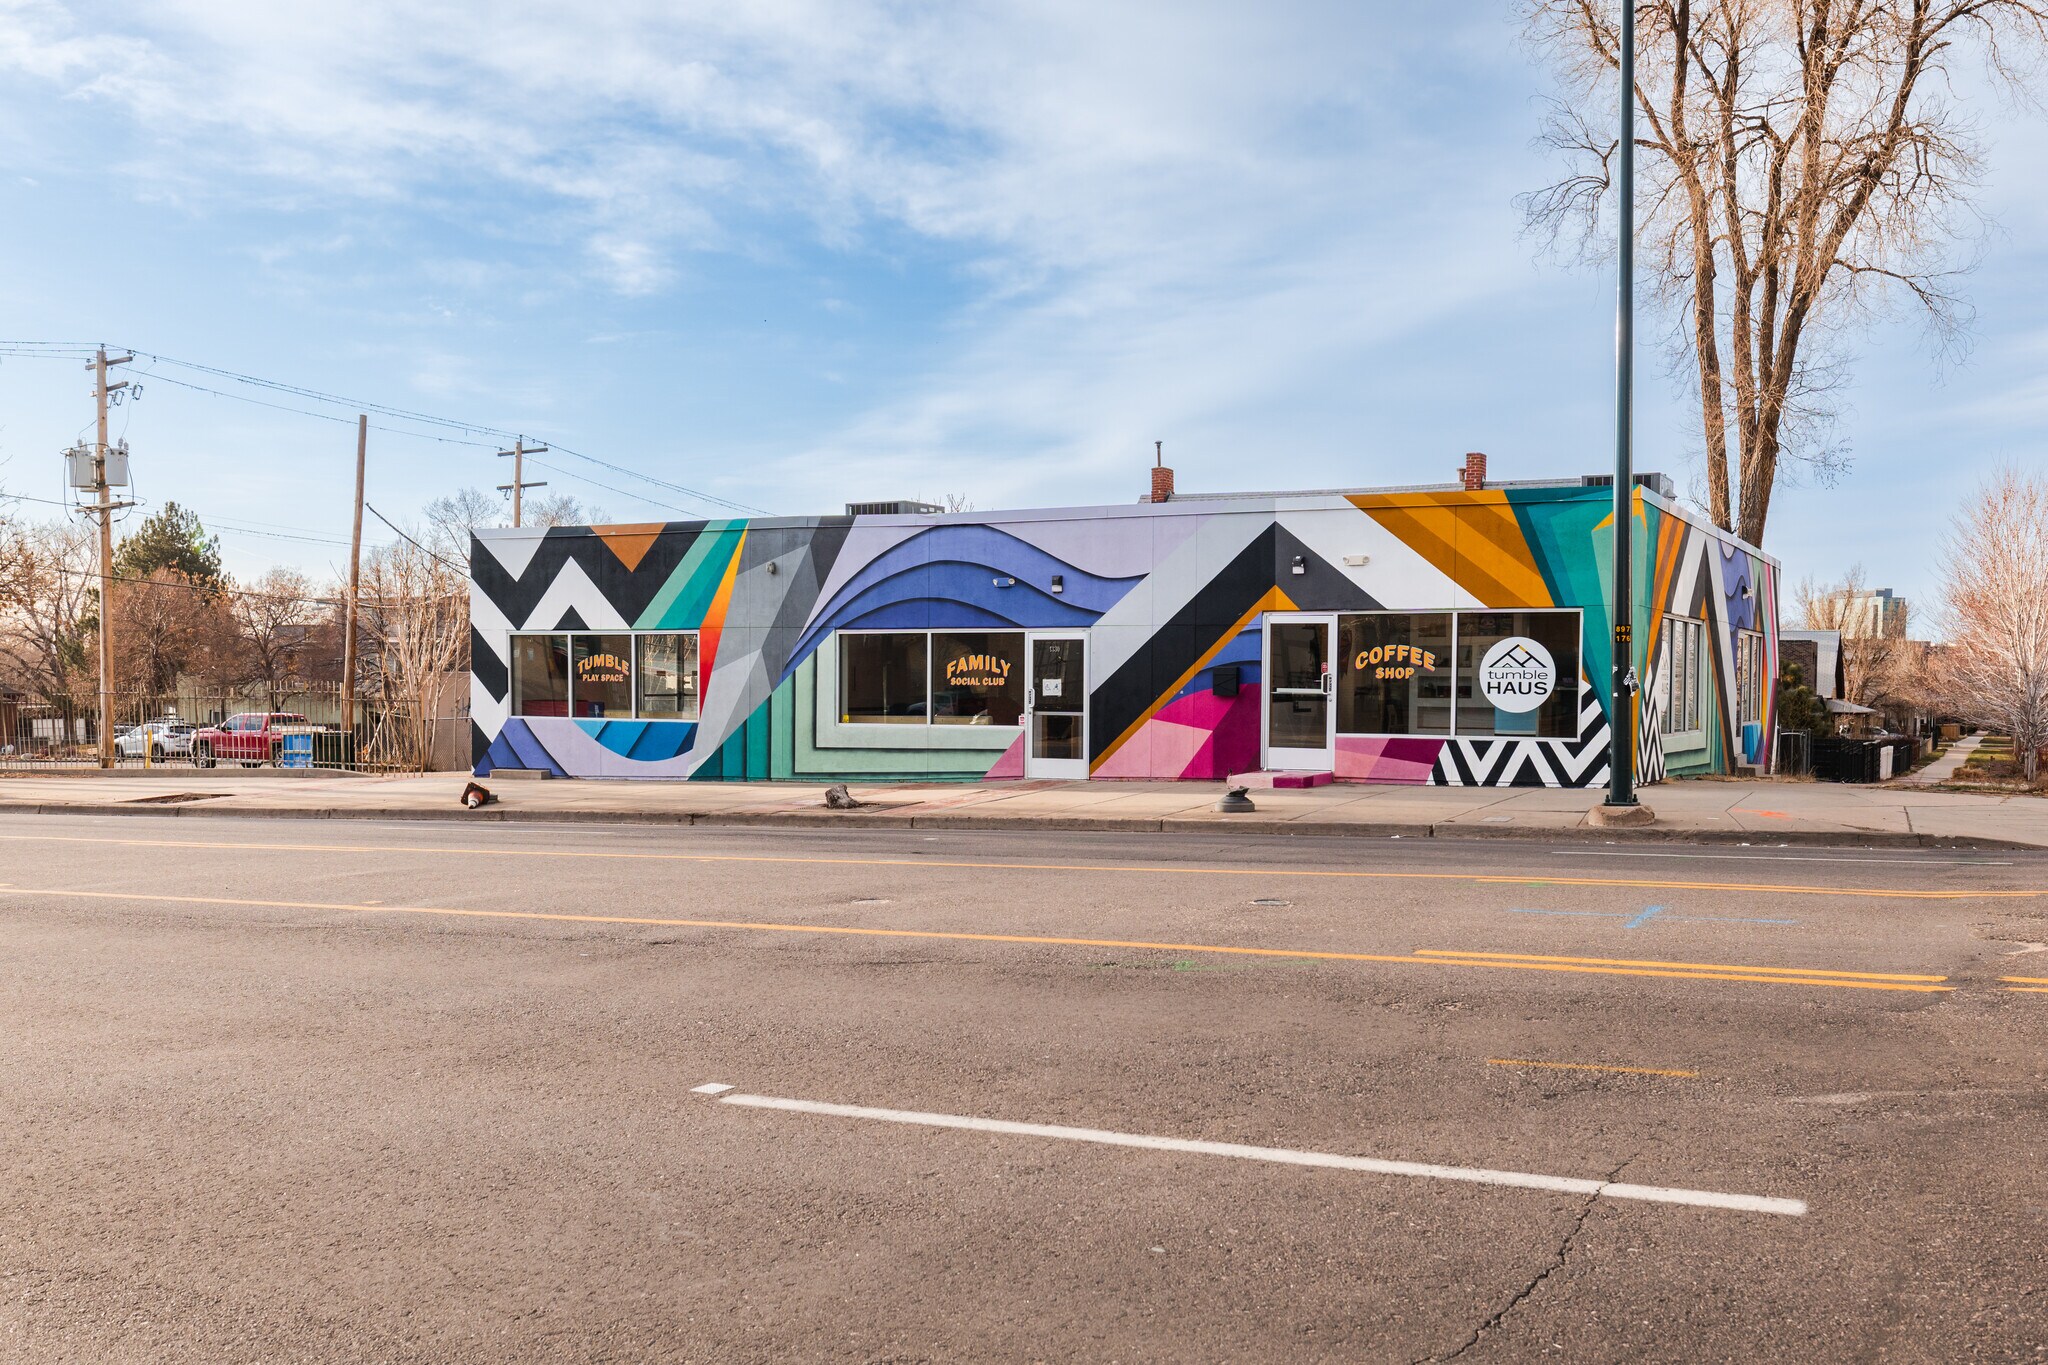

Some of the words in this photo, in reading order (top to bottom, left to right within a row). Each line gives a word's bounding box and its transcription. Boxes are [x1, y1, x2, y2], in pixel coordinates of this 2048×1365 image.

[577, 654, 629, 676] TUMBLE
[1355, 645, 1436, 672] COFFEE
[946, 655, 1011, 679] FAMILY
[1375, 667, 1415, 679] SHOP
[582, 674, 599, 682] PLAY
[600, 674, 624, 682] SPACE
[1488, 670, 1548, 679] tumble
[950, 677, 980, 686] SOCIAL
[982, 677, 1005, 686] CLUB
[1487, 681, 1548, 695] HAUS
